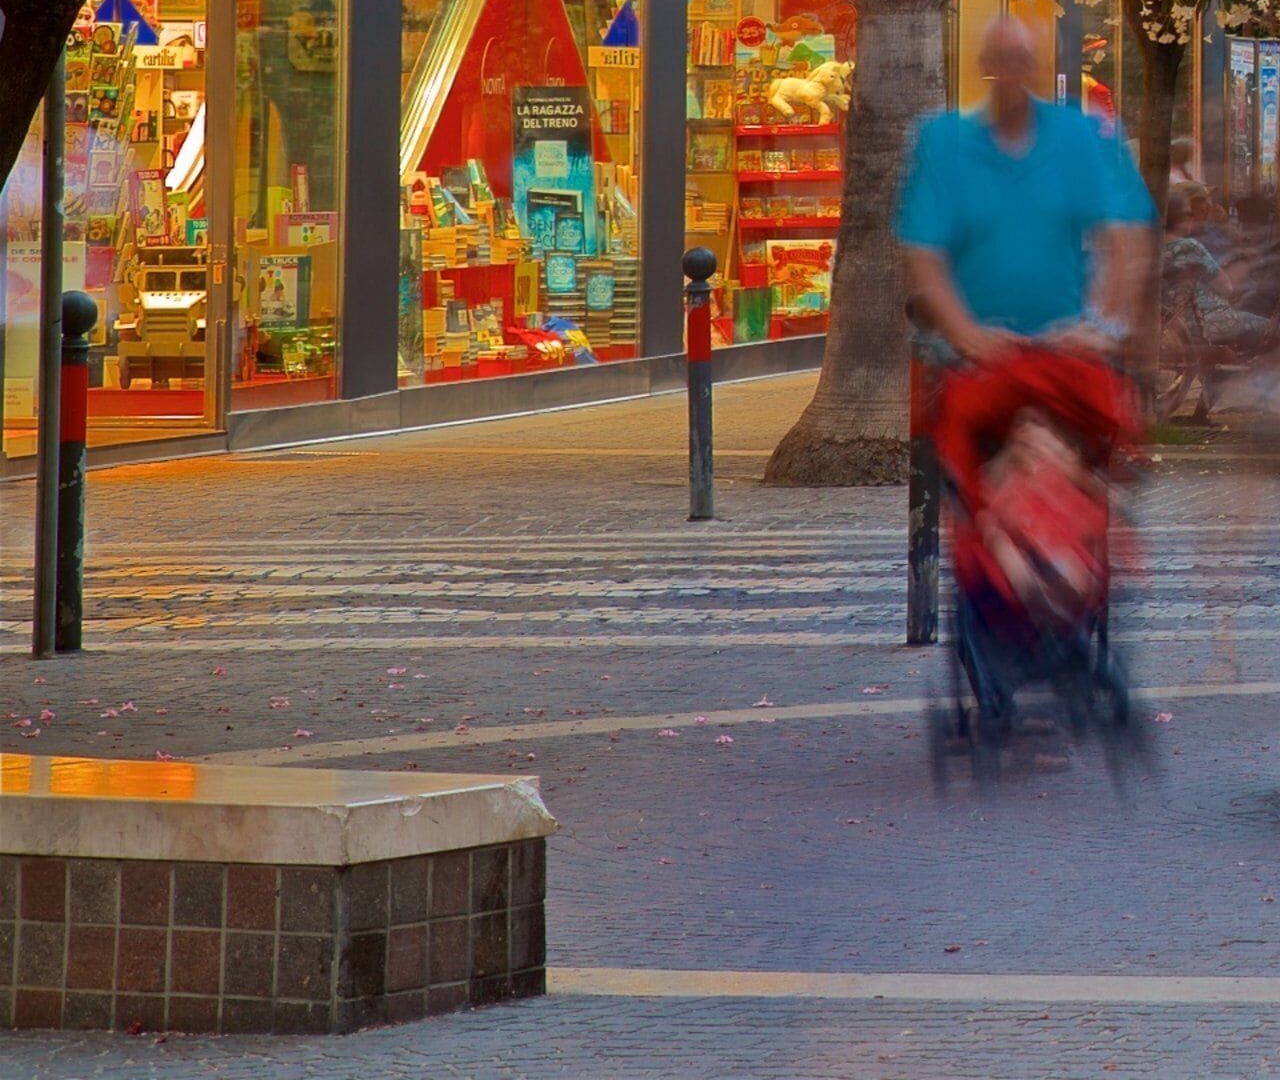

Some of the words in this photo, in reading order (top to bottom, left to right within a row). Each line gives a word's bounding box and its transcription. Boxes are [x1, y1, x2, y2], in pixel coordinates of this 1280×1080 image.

[516, 105, 530, 116] LA
[531, 104, 584, 116] RAGAZZA
[523, 118, 541, 129] DEL
[542, 118, 578, 128] TRENO
